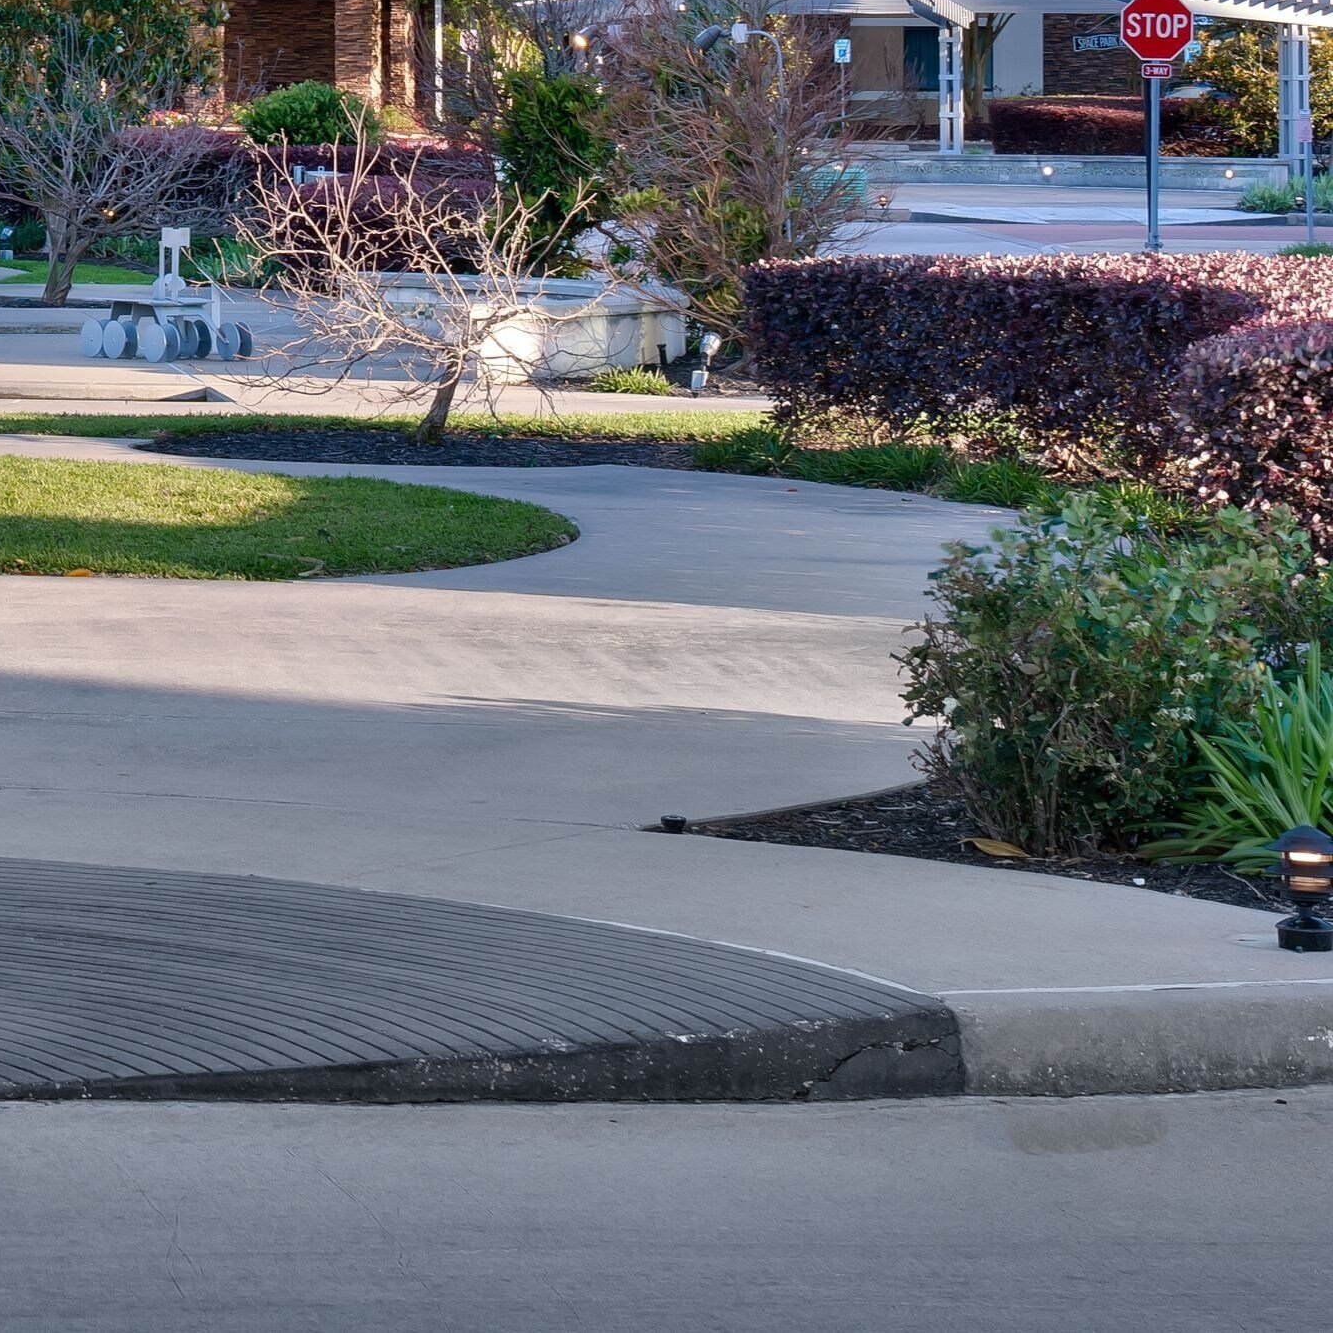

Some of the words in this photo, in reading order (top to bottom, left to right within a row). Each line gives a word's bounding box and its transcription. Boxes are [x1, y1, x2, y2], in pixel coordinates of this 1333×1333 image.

[1125, 12, 1189, 39] STOP
[1077, 37, 1100, 50] SPACE
[1144, 66, 1169, 76] 3-WAY
